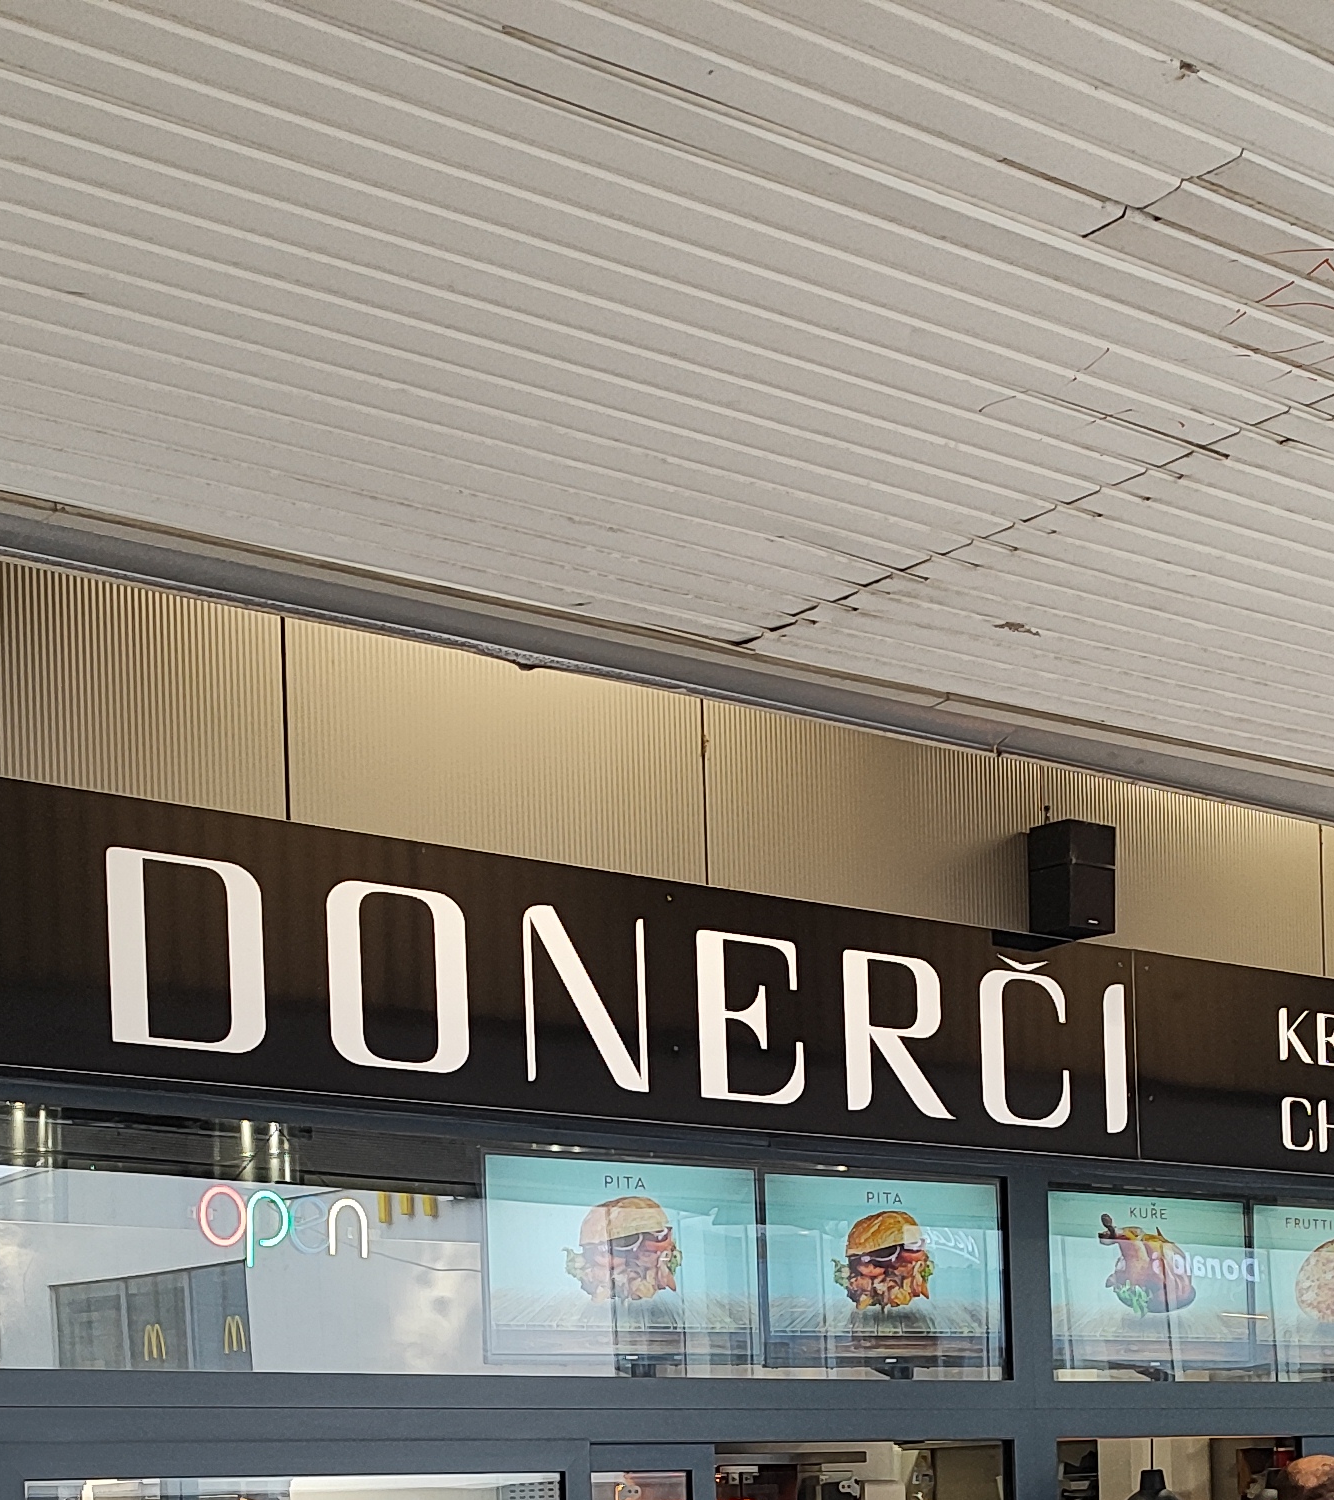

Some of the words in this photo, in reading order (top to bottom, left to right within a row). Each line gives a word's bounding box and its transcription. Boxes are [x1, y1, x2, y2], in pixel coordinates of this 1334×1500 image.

[105, 846, 1128, 1134] DONERČI
[605, 1176, 645, 1189] PITA
[867, 1192, 902, 1204] PITA
[1130, 1202, 1167, 1219] KUŘE
[199, 1184, 368, 1267] open
[1286, 1217, 1331, 1230] FRUTTI
